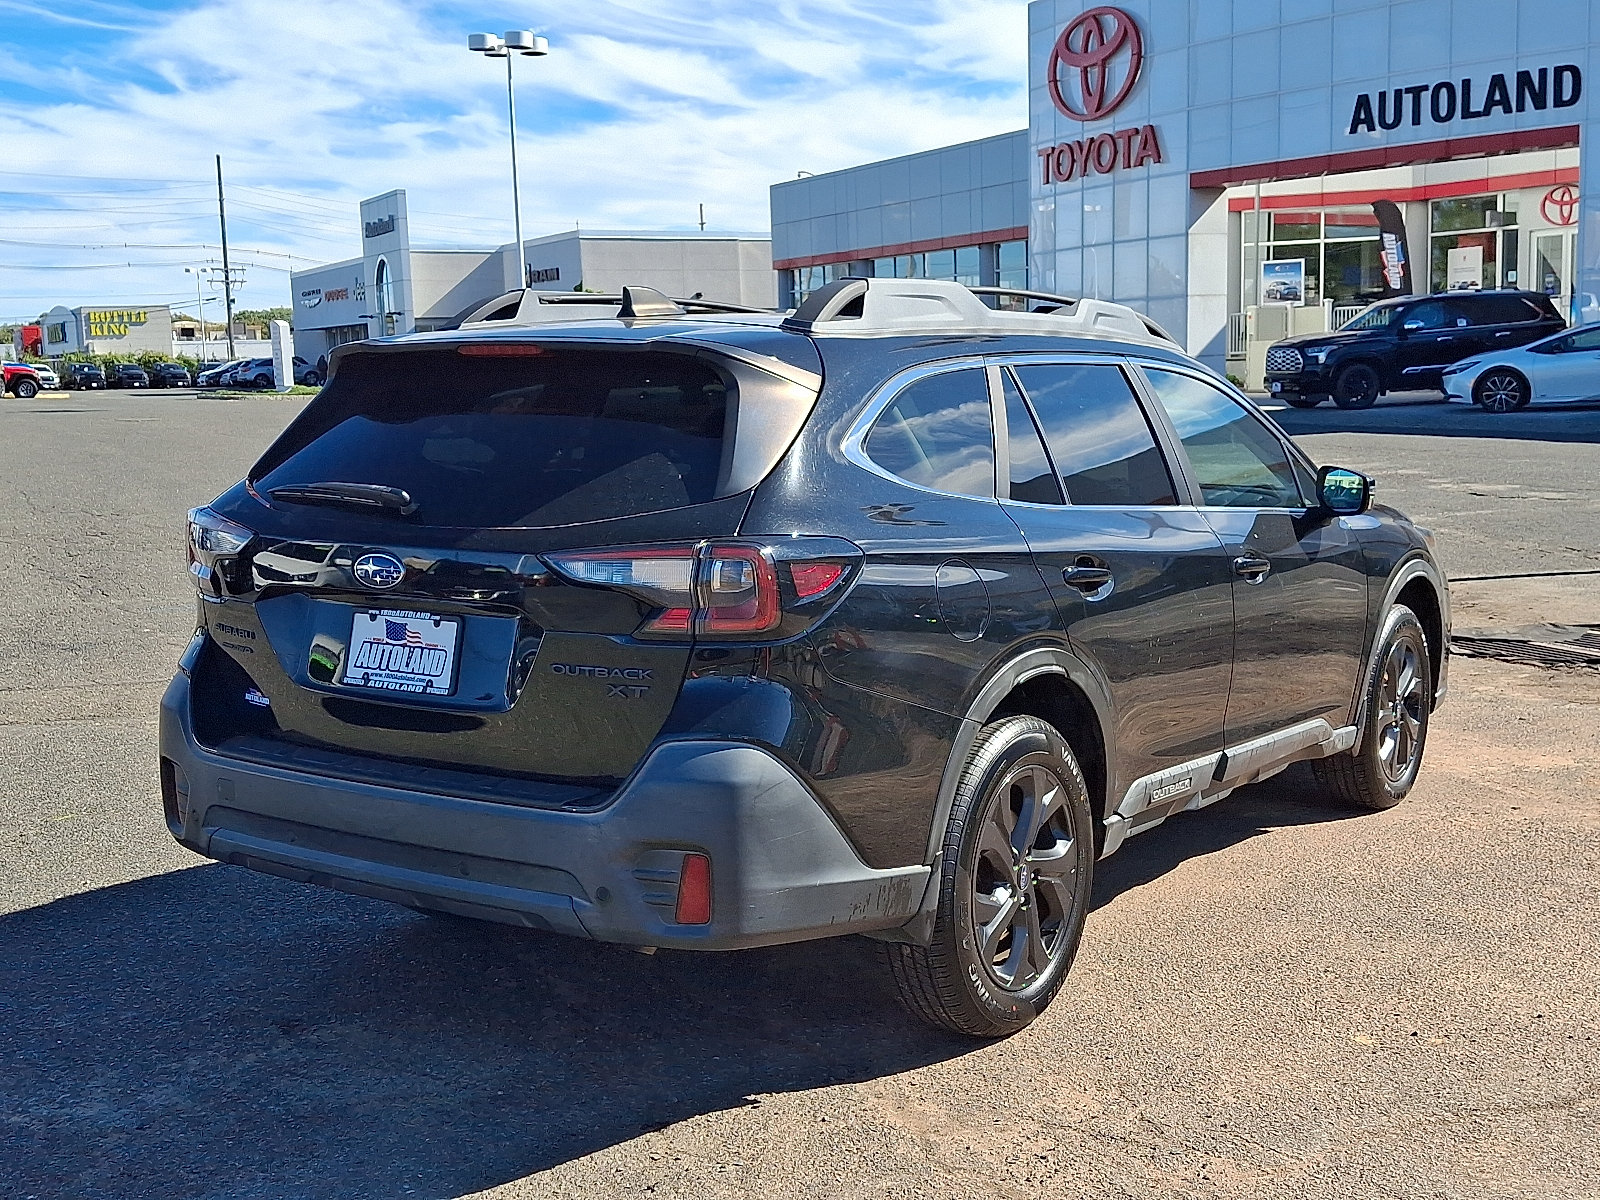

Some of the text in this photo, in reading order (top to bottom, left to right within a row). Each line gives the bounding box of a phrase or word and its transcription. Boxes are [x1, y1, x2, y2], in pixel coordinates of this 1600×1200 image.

[1349, 64, 1582, 134] AUTOLAND
[1037, 124, 1162, 185] TOYOTA
[531, 267, 560, 283] RAM
[88, 310, 148, 323] BOTTLE
[89, 323, 131, 337] KING
[354, 641, 448, 677] AUTOLAND
[550, 663, 654, 680] OUTBACK
[367, 680, 424, 693] AUTOLAND
[606, 683, 651, 699] XT
[1152, 778, 1191, 799] OUTBACK
